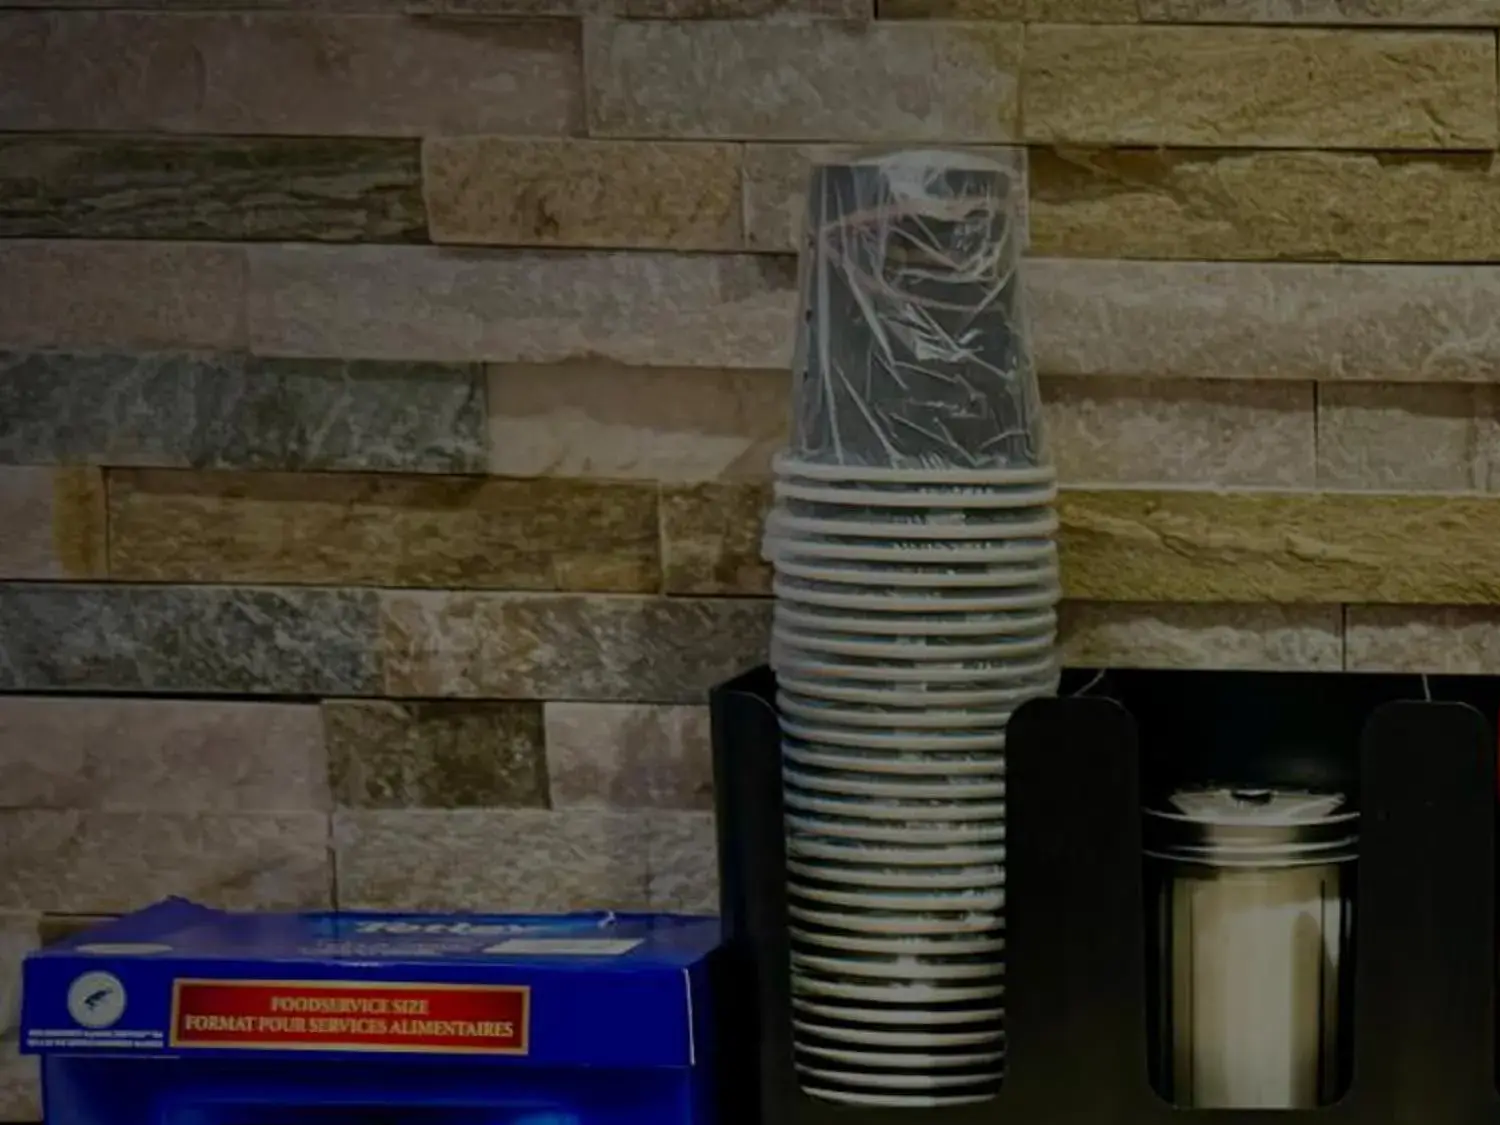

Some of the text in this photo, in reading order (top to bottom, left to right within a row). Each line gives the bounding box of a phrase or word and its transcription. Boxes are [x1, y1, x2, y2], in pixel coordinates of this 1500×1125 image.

[184, 1013, 256, 1032] FORMAT
[259, 1015, 306, 1033] POUR
[308, 1016, 388, 1035] SERVICES
